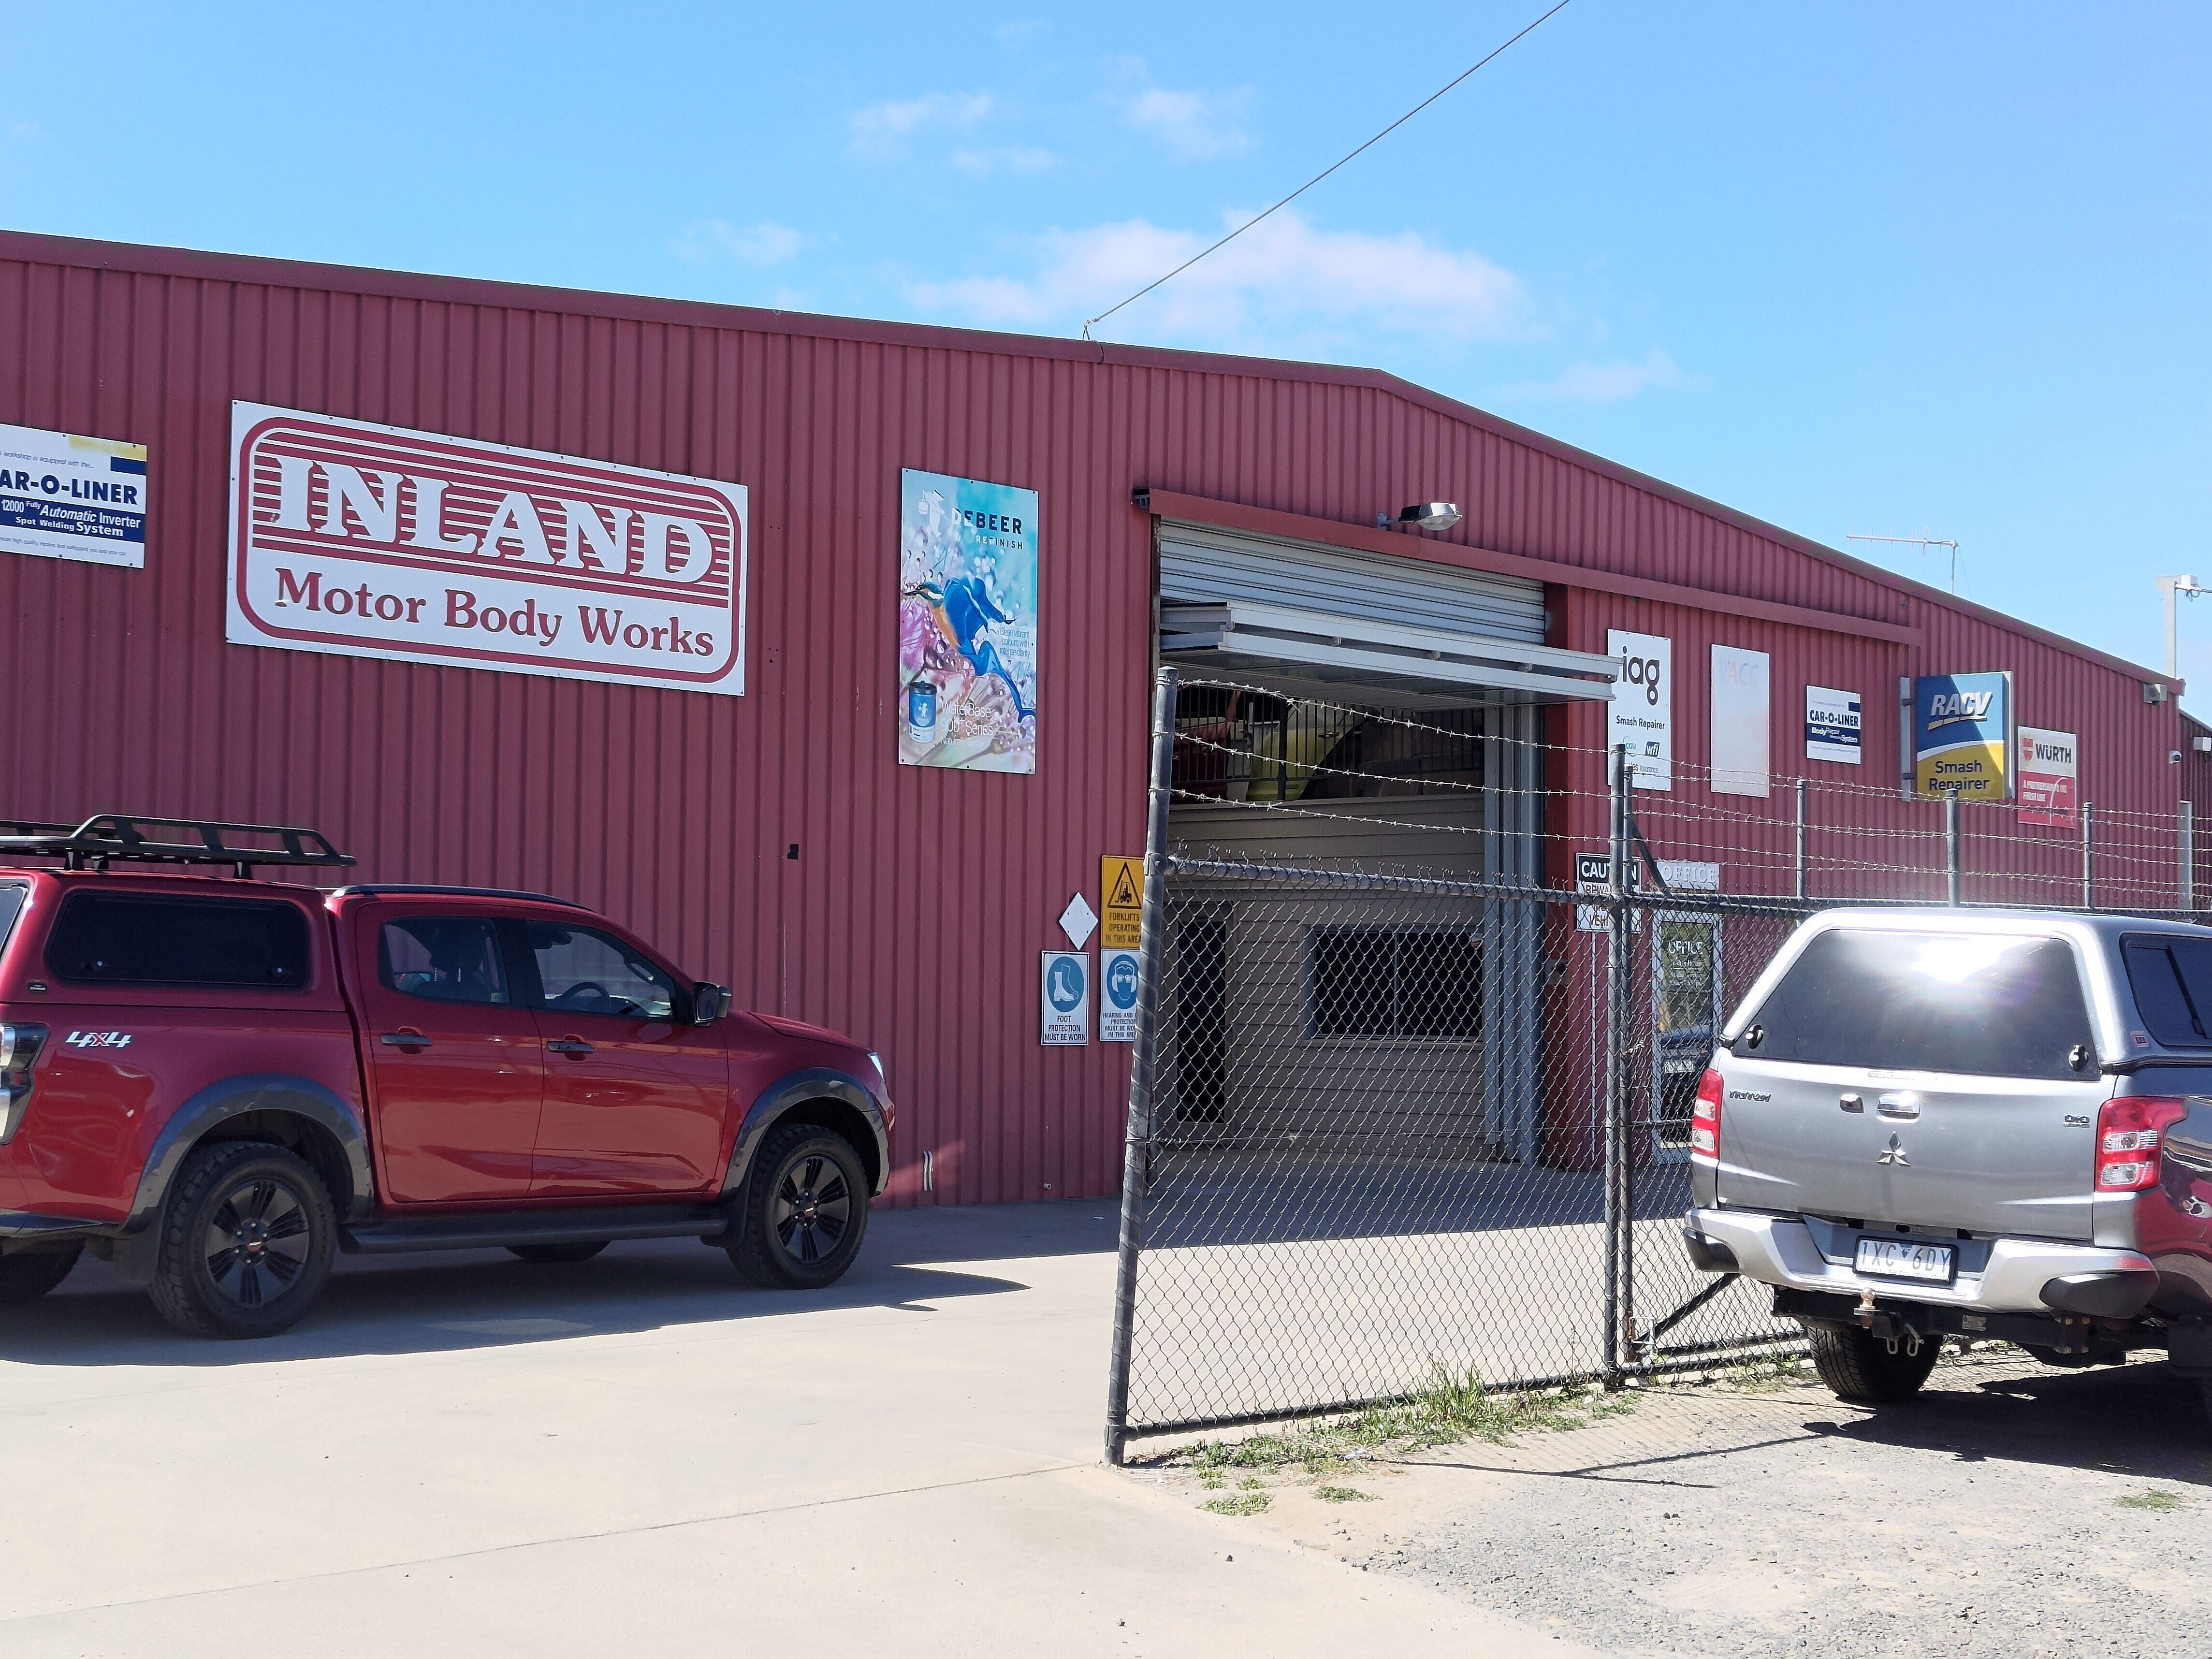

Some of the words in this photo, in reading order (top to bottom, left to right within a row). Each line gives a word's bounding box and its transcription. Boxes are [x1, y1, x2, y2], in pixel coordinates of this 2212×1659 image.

[4, 451, 32, 461] workshop
[40, 456, 67, 465] equipped
[0, 469, 138, 505] AR-O-LINER
[26, 500, 41, 510] Fully
[39, 504, 97, 523] Automatic
[99, 512, 141, 528] Inverter
[271, 454, 713, 584] INLAND
[16, 516, 37, 526] Spot
[40, 519, 75, 532] Welding
[76, 521, 124, 537] System
[975, 535, 1023, 550] REFINISH
[275, 567, 427, 624] Motor
[444, 588, 563, 648] Body
[578, 605, 714, 657] Works
[1000, 626, 1013, 637] Clean
[1014, 628, 1029, 639] vibrant
[1002, 636, 1019, 647] colours
[1019, 638, 1030, 648] with
[1000, 646, 1017, 656] intense
[1622, 646, 1660, 706] iag
[1931, 691, 1994, 716] RACV
[1616, 715, 1637, 727] Smash
[1639, 717, 1665, 730] Repairer
[1809, 710, 1859, 727] CAR-O-LINER
[966, 720, 993, 736] Series
[1811, 727, 1827, 736] Body
[1935, 759, 1982, 773] Smash
[1929, 777, 1990, 791] Repairer
[1581, 861, 1637, 880] CAUN
[1663, 865, 1716, 884] OFFICE
[1109, 912, 1140, 922] FORKLIFTS
[1109, 923, 1140, 932] OPERATING
[1106, 934, 1111, 943] IN
[1113, 934, 1126, 943] THIS
[1045, 1033, 1060, 1041] MUST
[1729, 1090, 1772, 1102] TRITON
[1862, 1241, 1896, 1267] 1XC
[1912, 1248, 1951, 1273] 6DY
